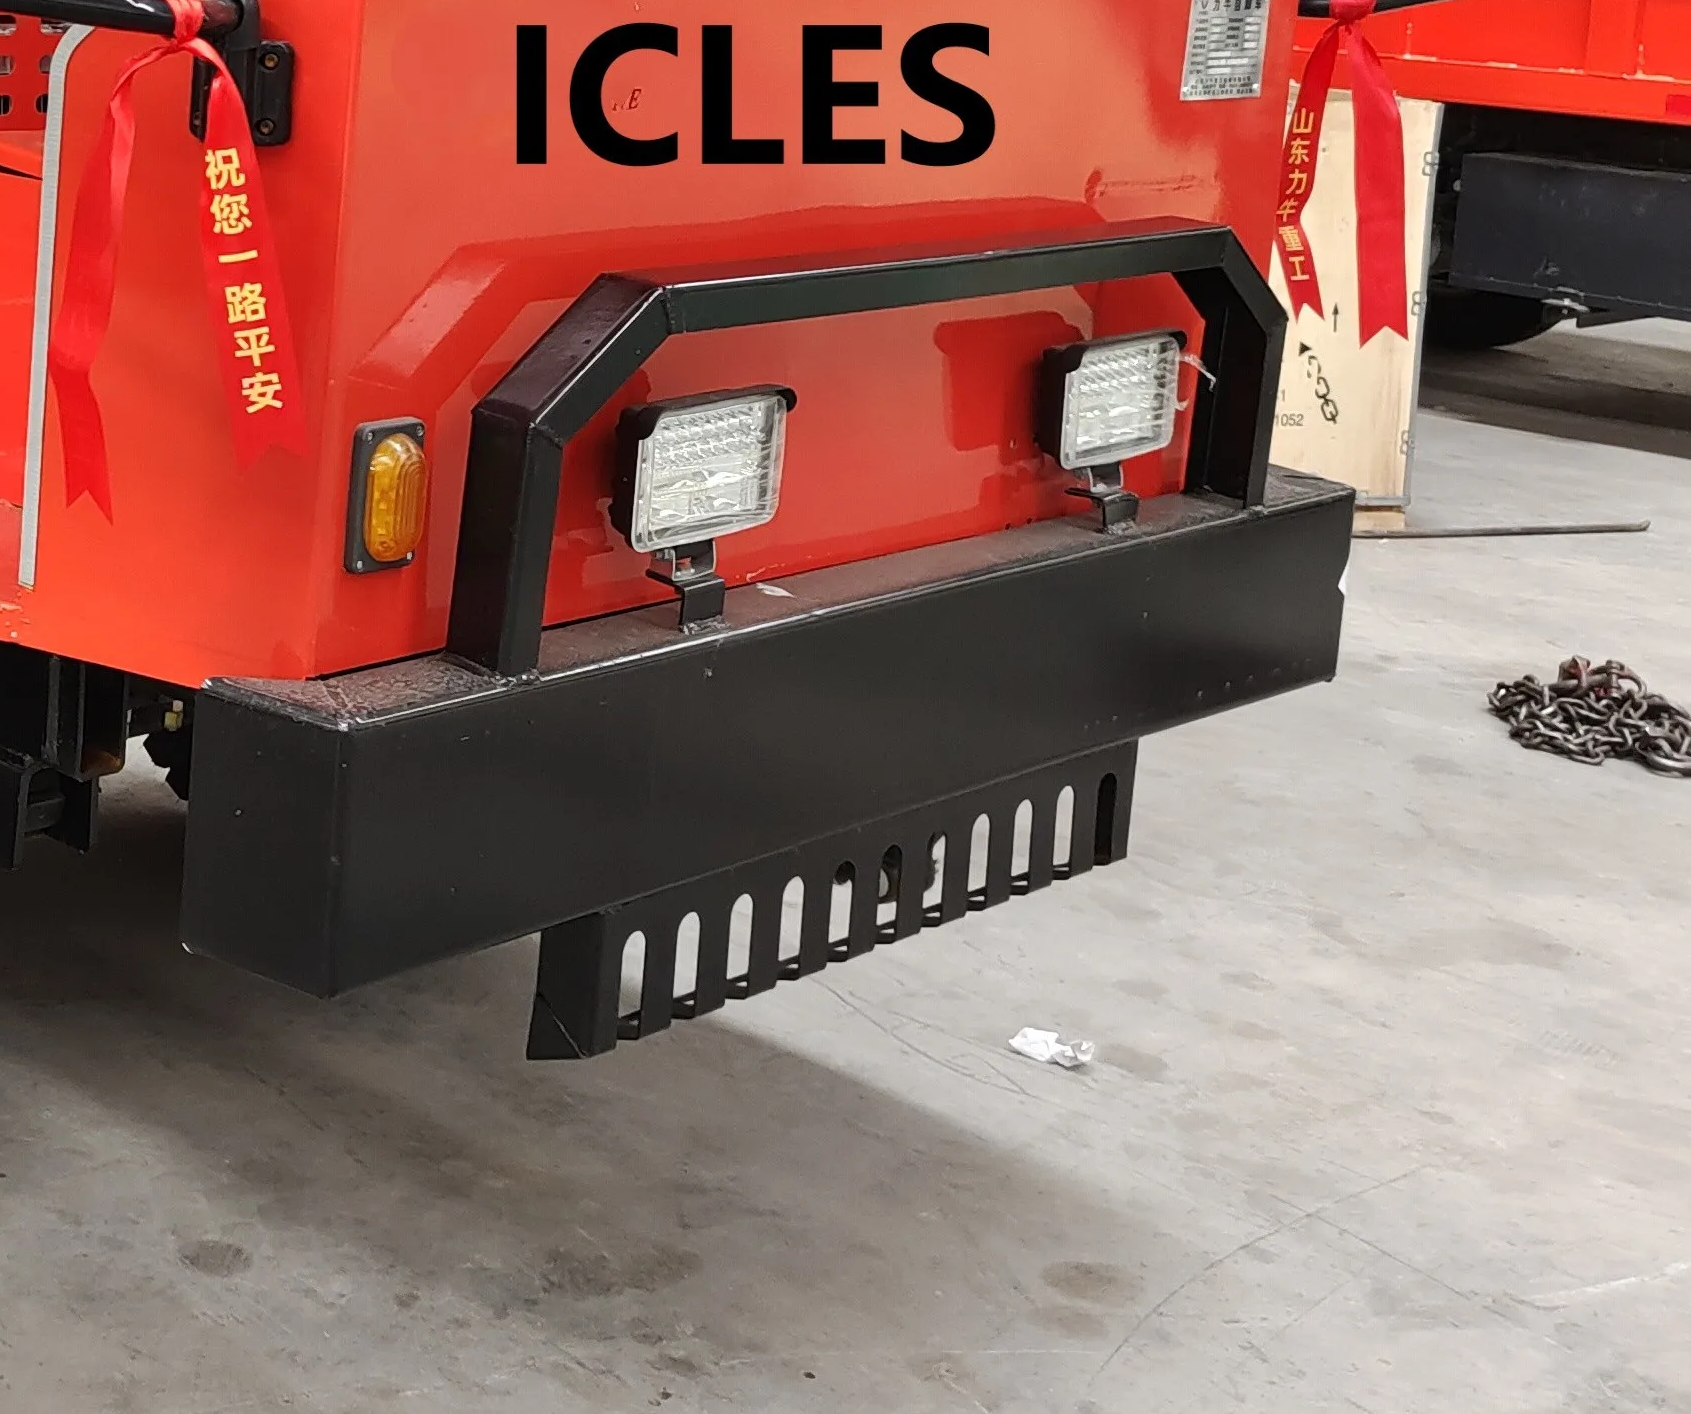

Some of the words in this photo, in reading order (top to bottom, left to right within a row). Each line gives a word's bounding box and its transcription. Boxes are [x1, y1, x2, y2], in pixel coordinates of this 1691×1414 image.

[204, 147, 284, 415] 祝您一路平安
[1275, 107, 1315, 282] 山东力牛重工
